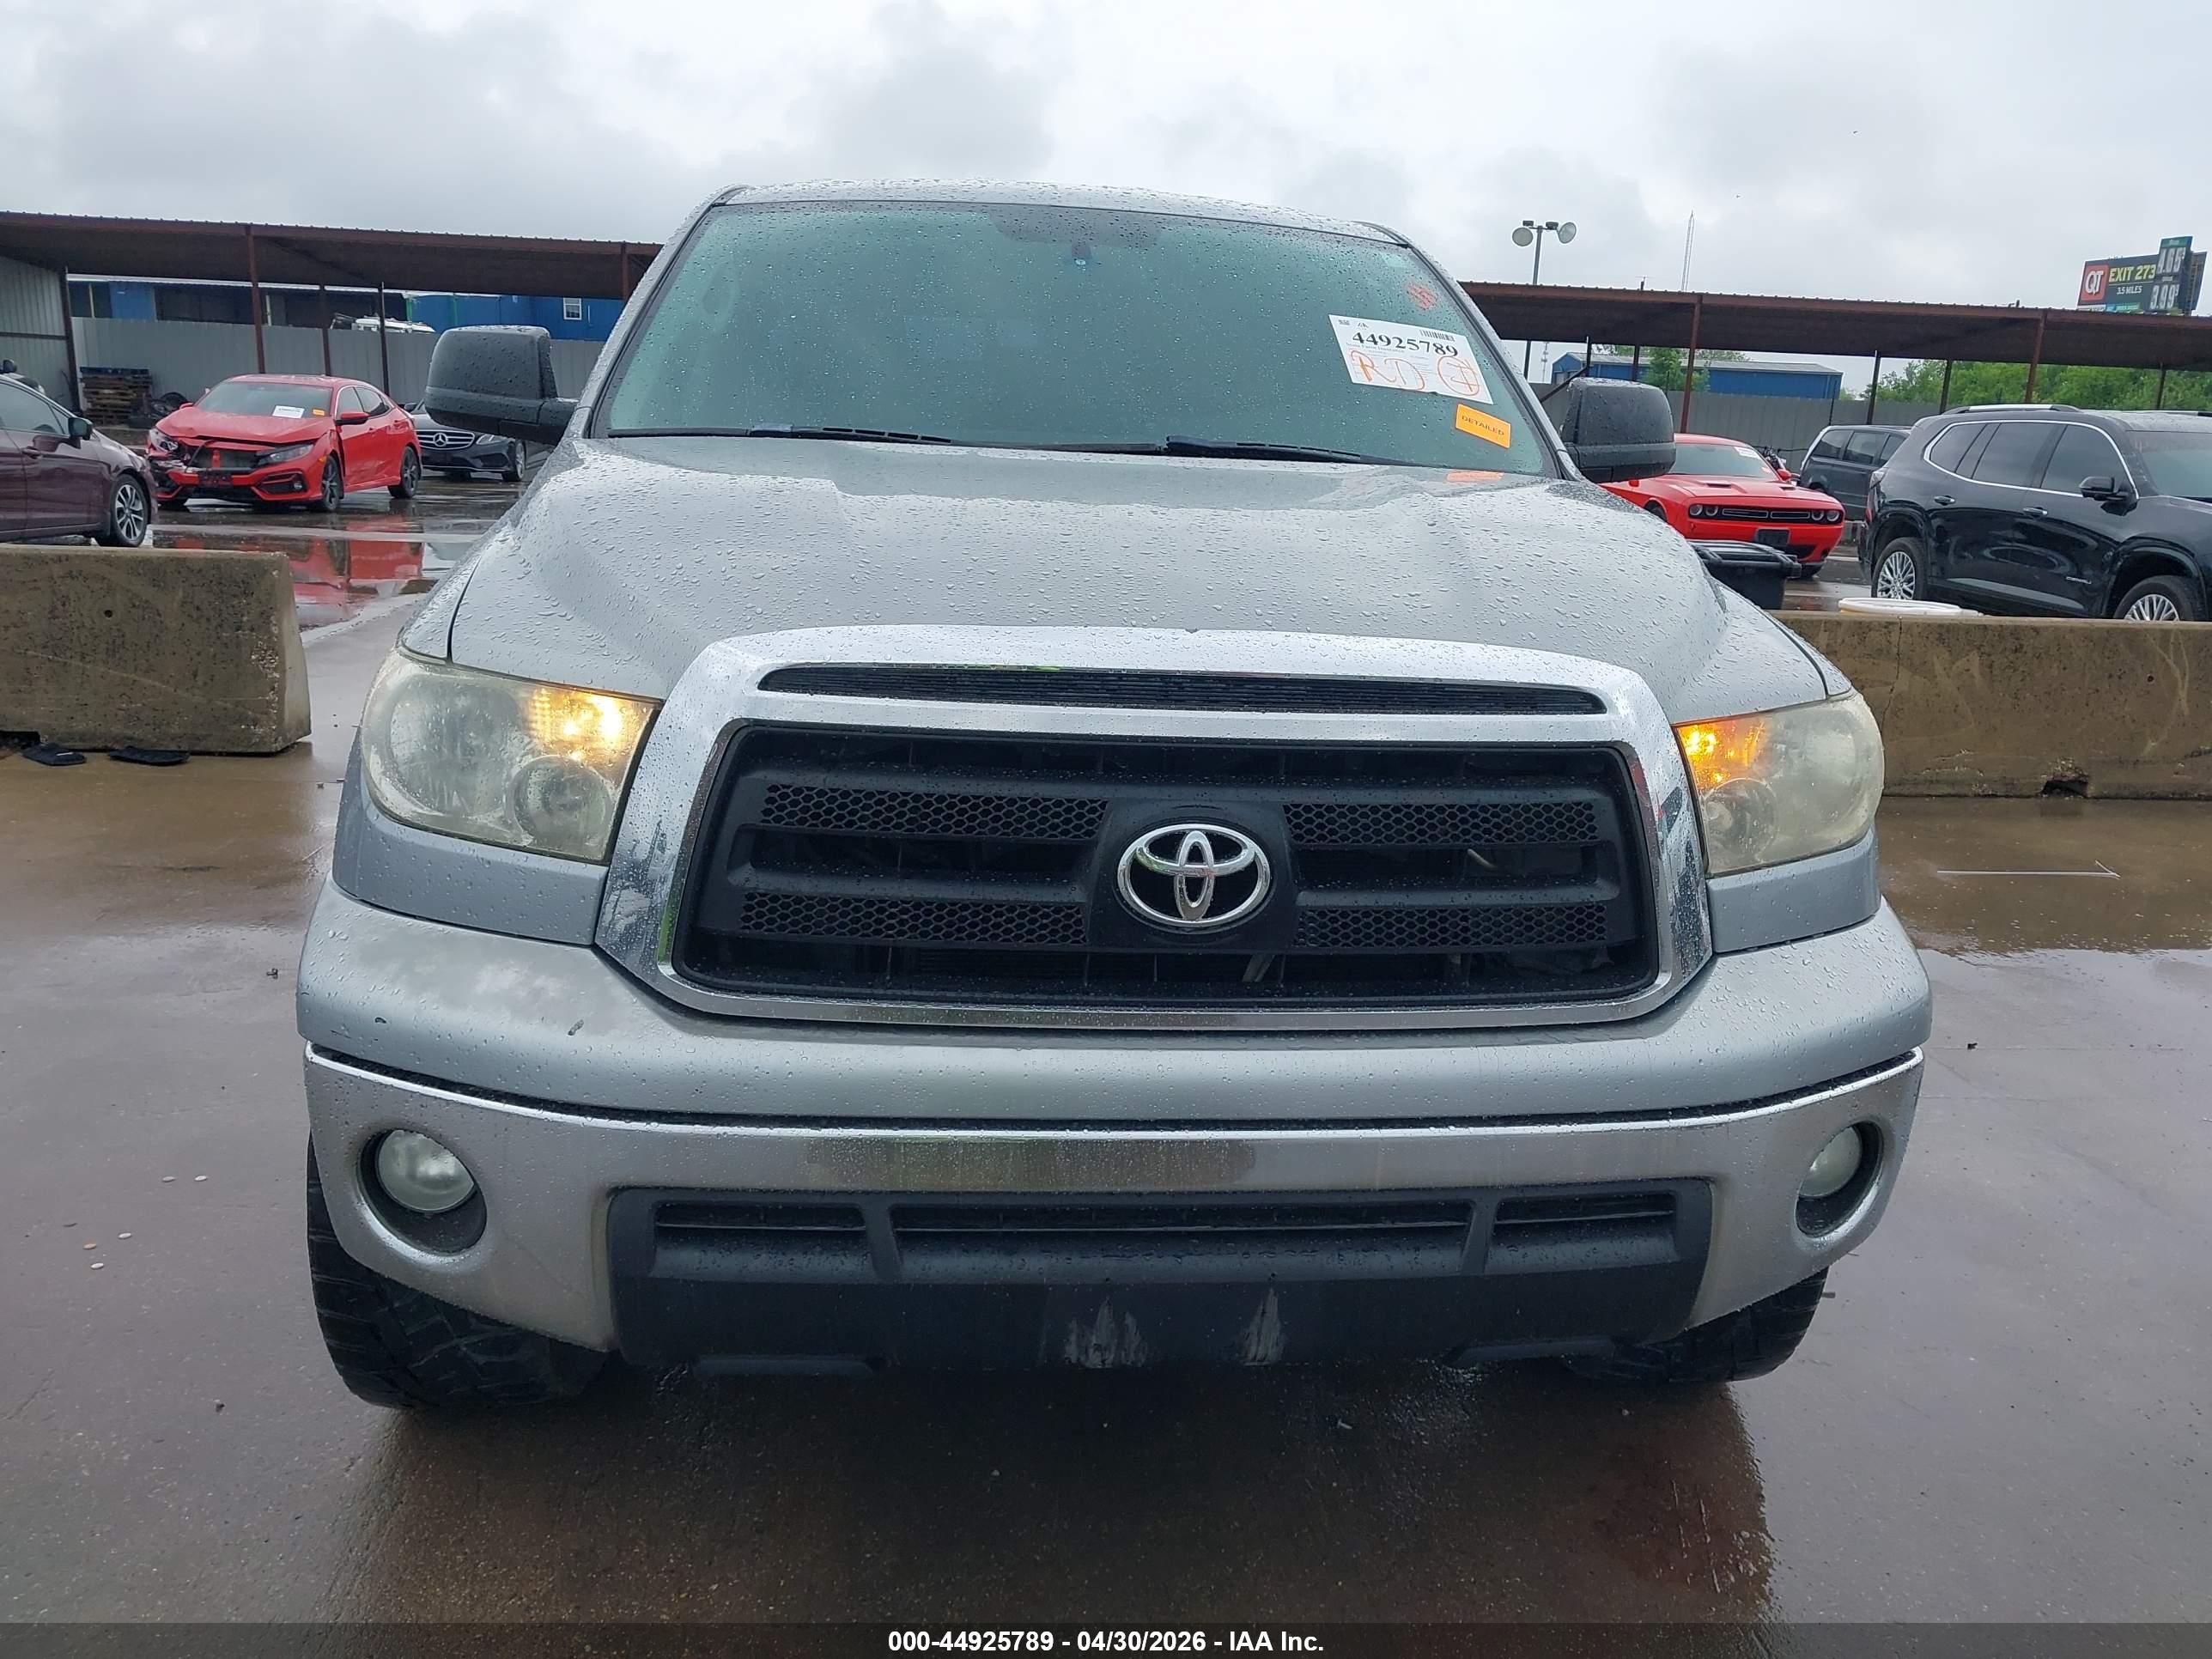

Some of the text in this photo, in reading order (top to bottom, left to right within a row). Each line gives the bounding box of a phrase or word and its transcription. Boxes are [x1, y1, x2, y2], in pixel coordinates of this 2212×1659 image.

[2085, 270, 2104, 295] QT
[2108, 264, 2156, 283] EXIT 273
[2125, 285, 2142, 295] MILES
[1352, 331, 1458, 356] 44925789
[1462, 415, 1504, 435] DETAILED
